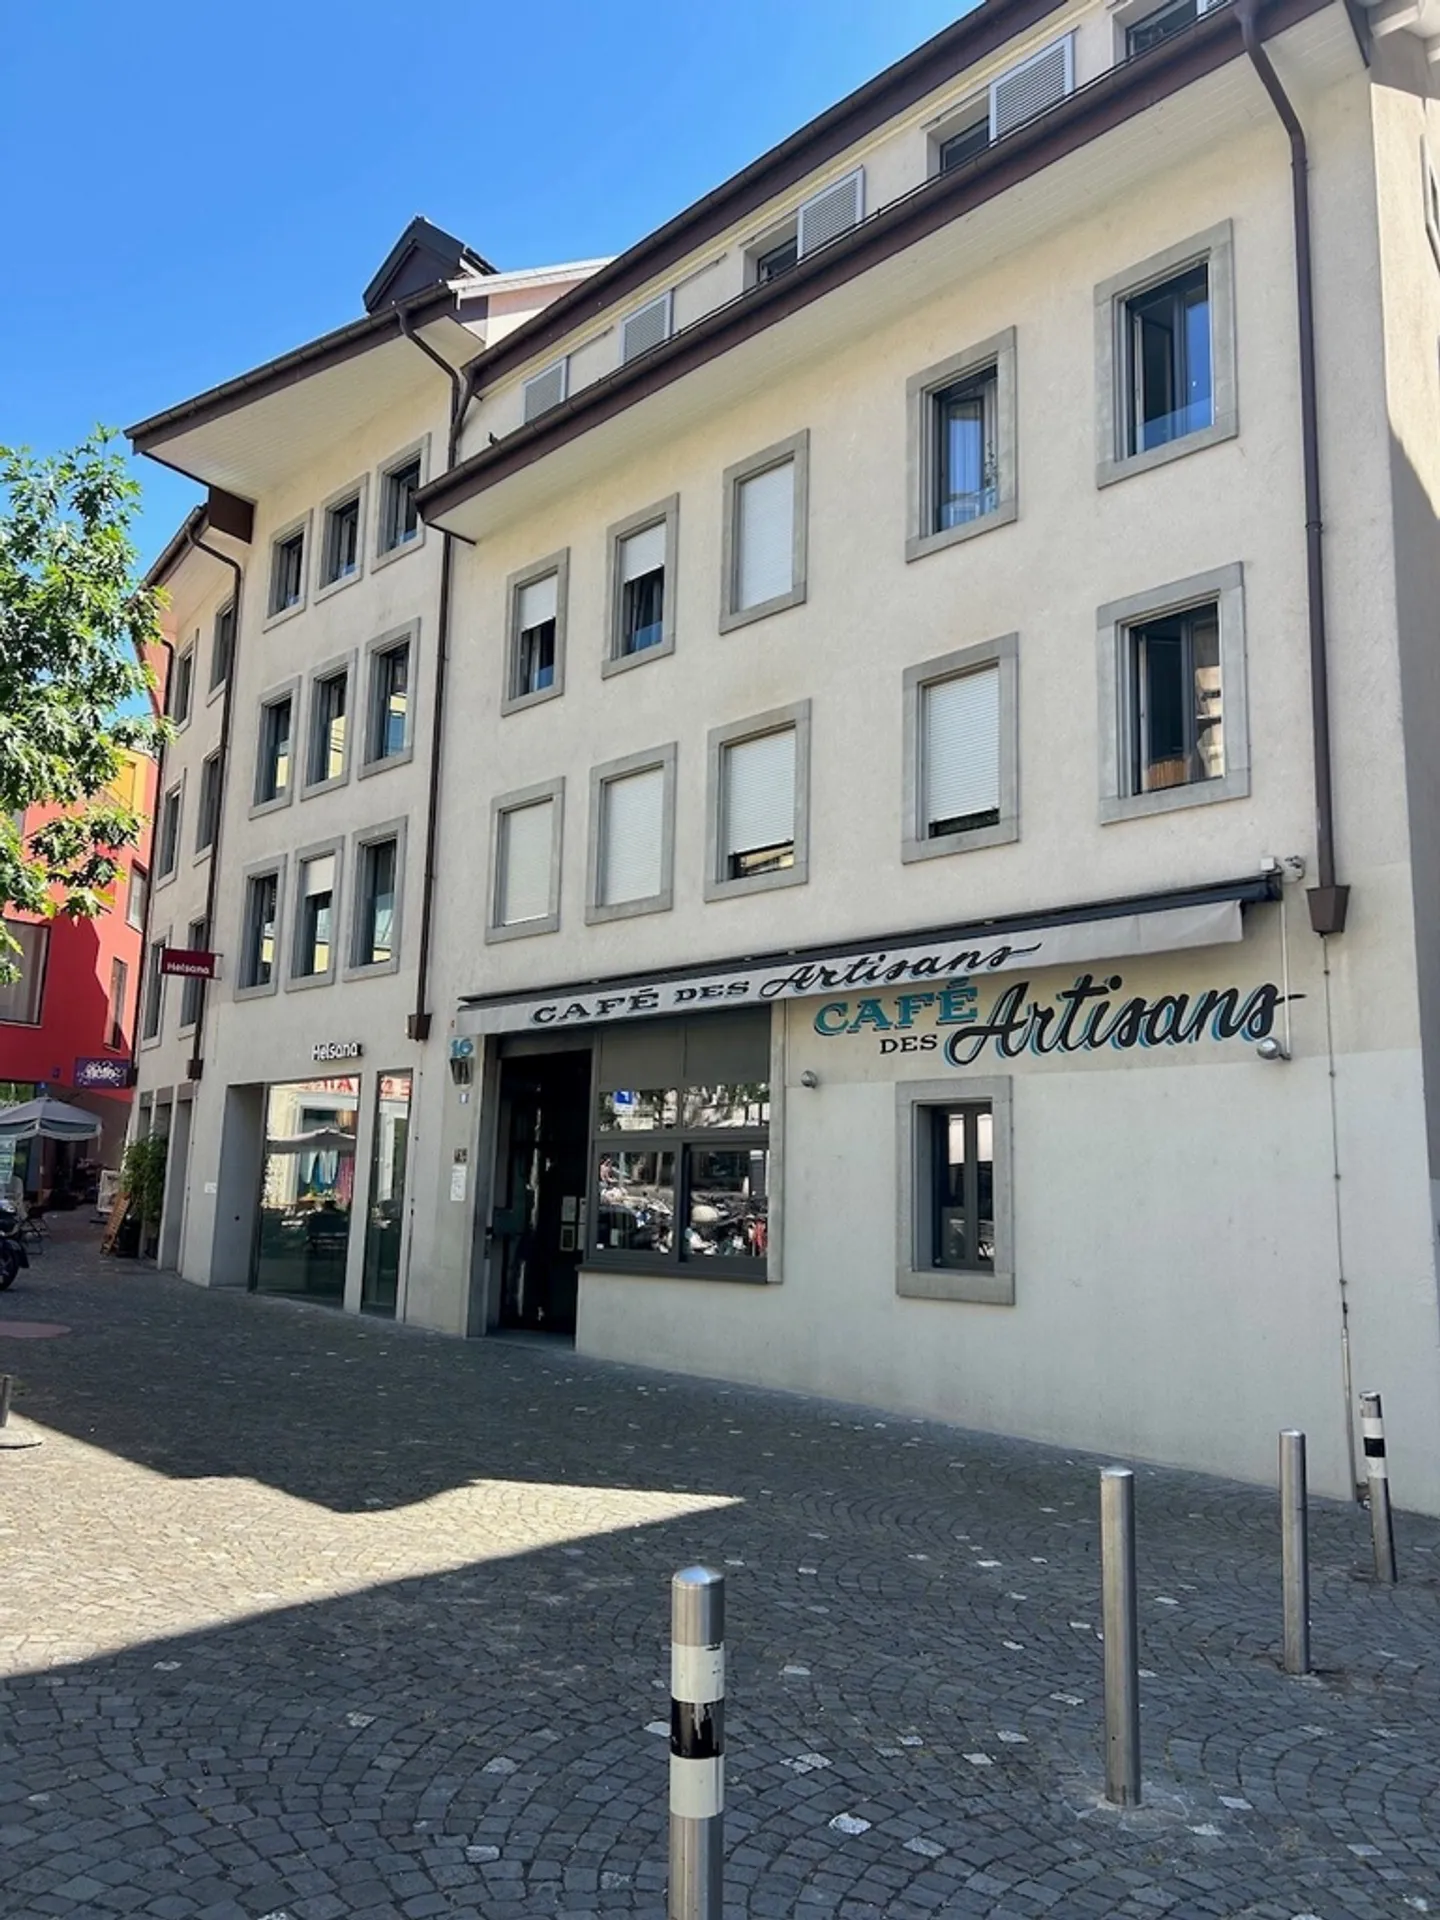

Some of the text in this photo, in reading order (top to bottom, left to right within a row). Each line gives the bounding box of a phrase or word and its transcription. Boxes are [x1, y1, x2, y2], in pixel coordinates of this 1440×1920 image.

[166, 961, 211, 974] Helsana
[532, 942, 1042, 1025] CAFÉ DES Artisans
[813, 976, 979, 1037] CAFÉ
[879, 973, 1307, 1068] DES Artisans
[311, 1041, 362, 1060] Helsana
[451, 1038, 474, 1057] 16
